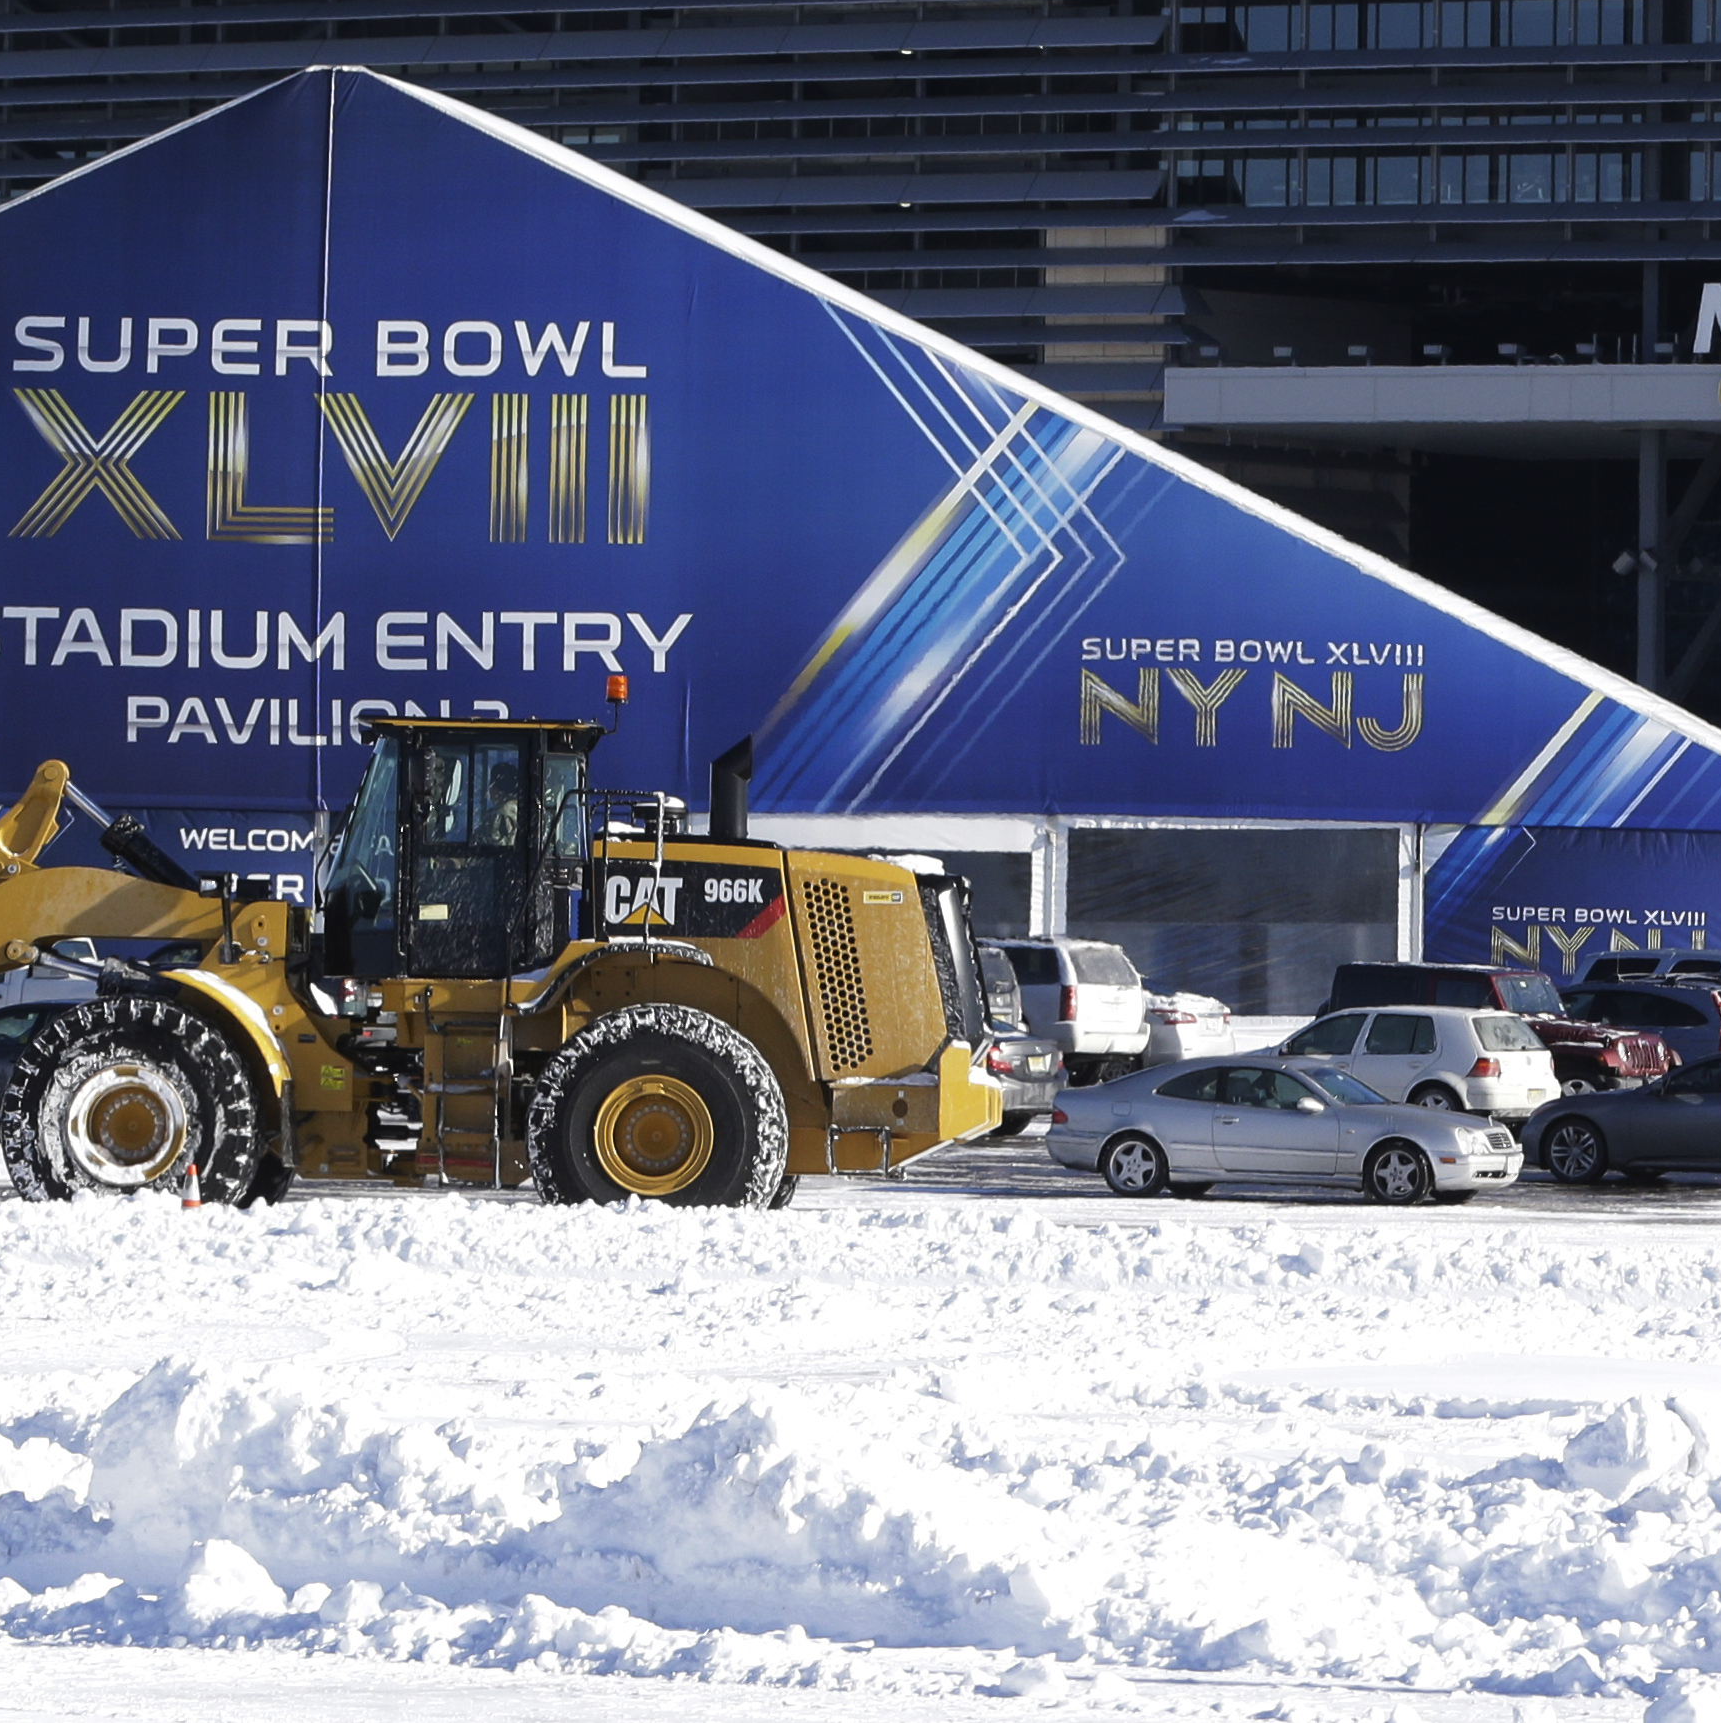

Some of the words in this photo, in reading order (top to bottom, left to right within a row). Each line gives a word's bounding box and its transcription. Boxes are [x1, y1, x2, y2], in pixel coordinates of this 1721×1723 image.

[12, 316, 333, 376] SUPER
[376, 320, 648, 379] BOWL
[8, 388, 650, 544] XLVIII
[375, 612, 693, 673] ENTRY
[1082, 638, 1201, 661] SUPER
[1215, 639, 1315, 665] BOWL
[1326, 642, 1424, 666] XLVIII
[1080, 667, 1247, 746] NY
[1271, 670, 1423, 752] NJ
[606, 876, 683, 925] CAT
[704, 878, 763, 903] 966K
[1492, 906, 1566, 922] SUPER
[1575, 908, 1637, 924] BOWL
[1644, 910, 1706, 926] XLVIII
[1491, 925, 1596, 975] NY
